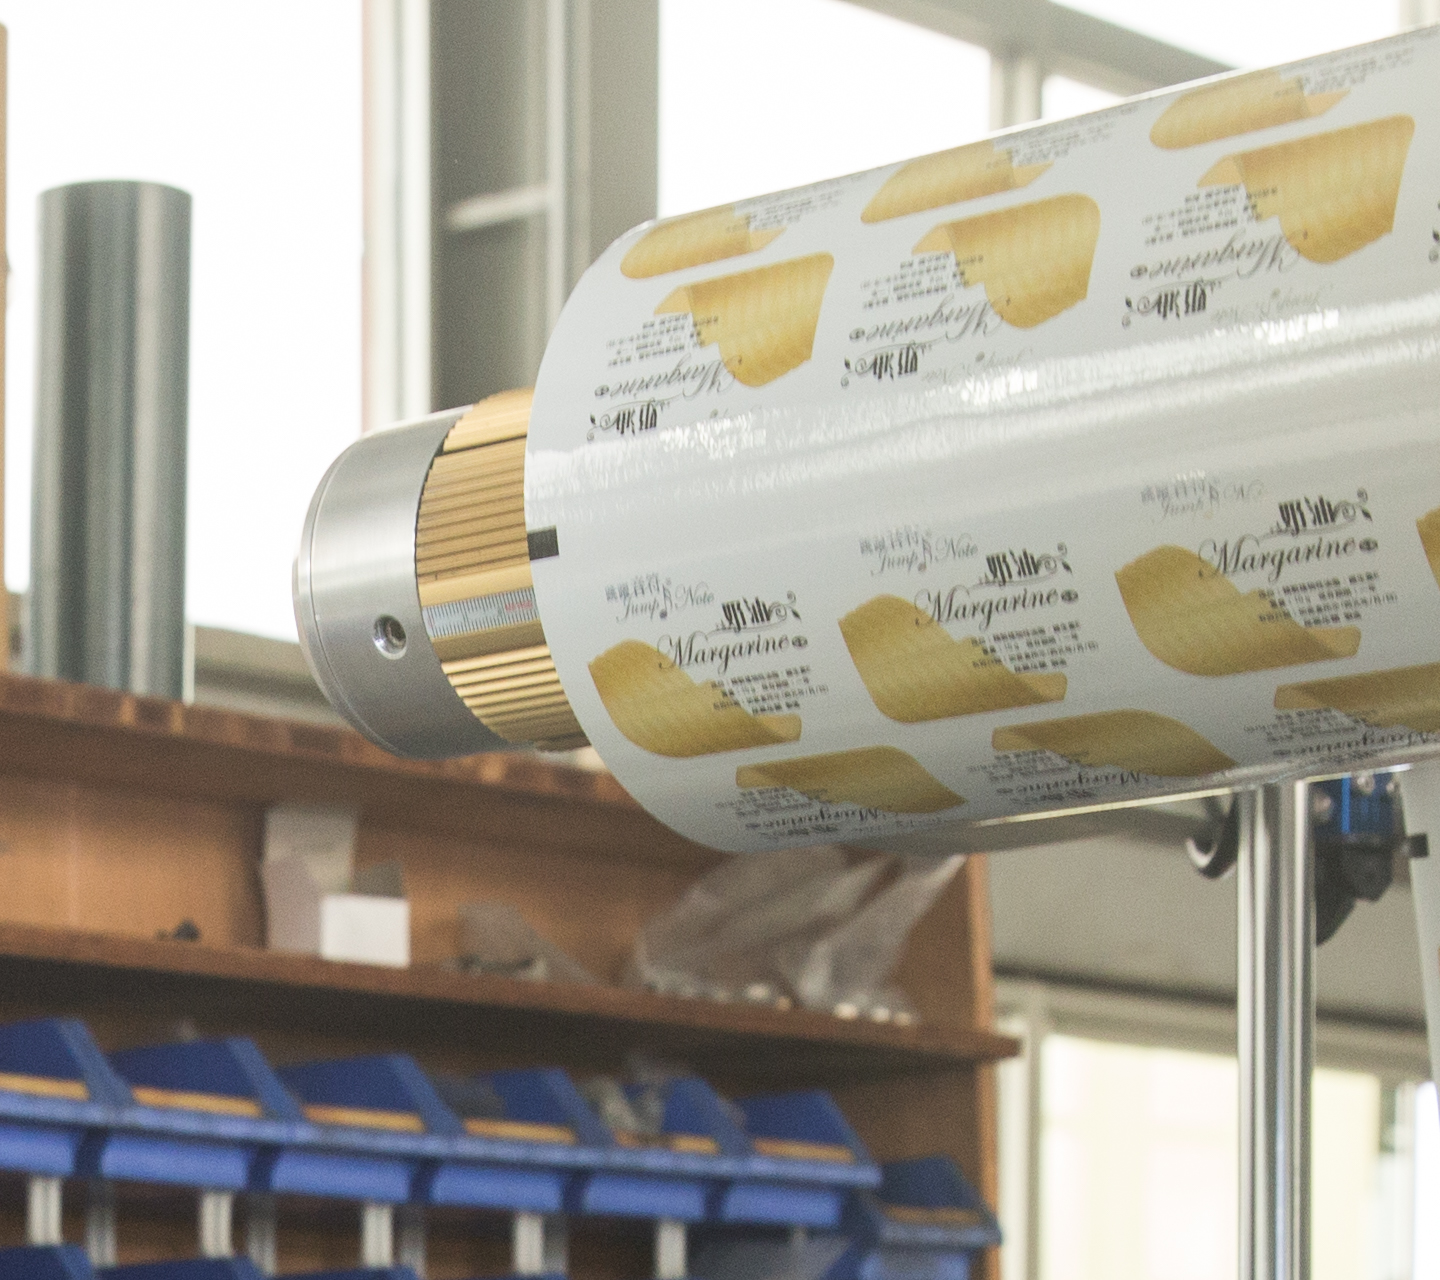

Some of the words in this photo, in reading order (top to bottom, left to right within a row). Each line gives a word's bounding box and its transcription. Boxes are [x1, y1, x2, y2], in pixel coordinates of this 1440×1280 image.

[870, 552, 921, 577] Jump
[935, 533, 979, 562] Note
[1197, 534, 1356, 583] Margarine
[615, 598, 665, 624] Jump
[674, 581, 716, 611] Note
[914, 584, 1058, 632] Margarine
[657, 630, 788, 675] Margarine
